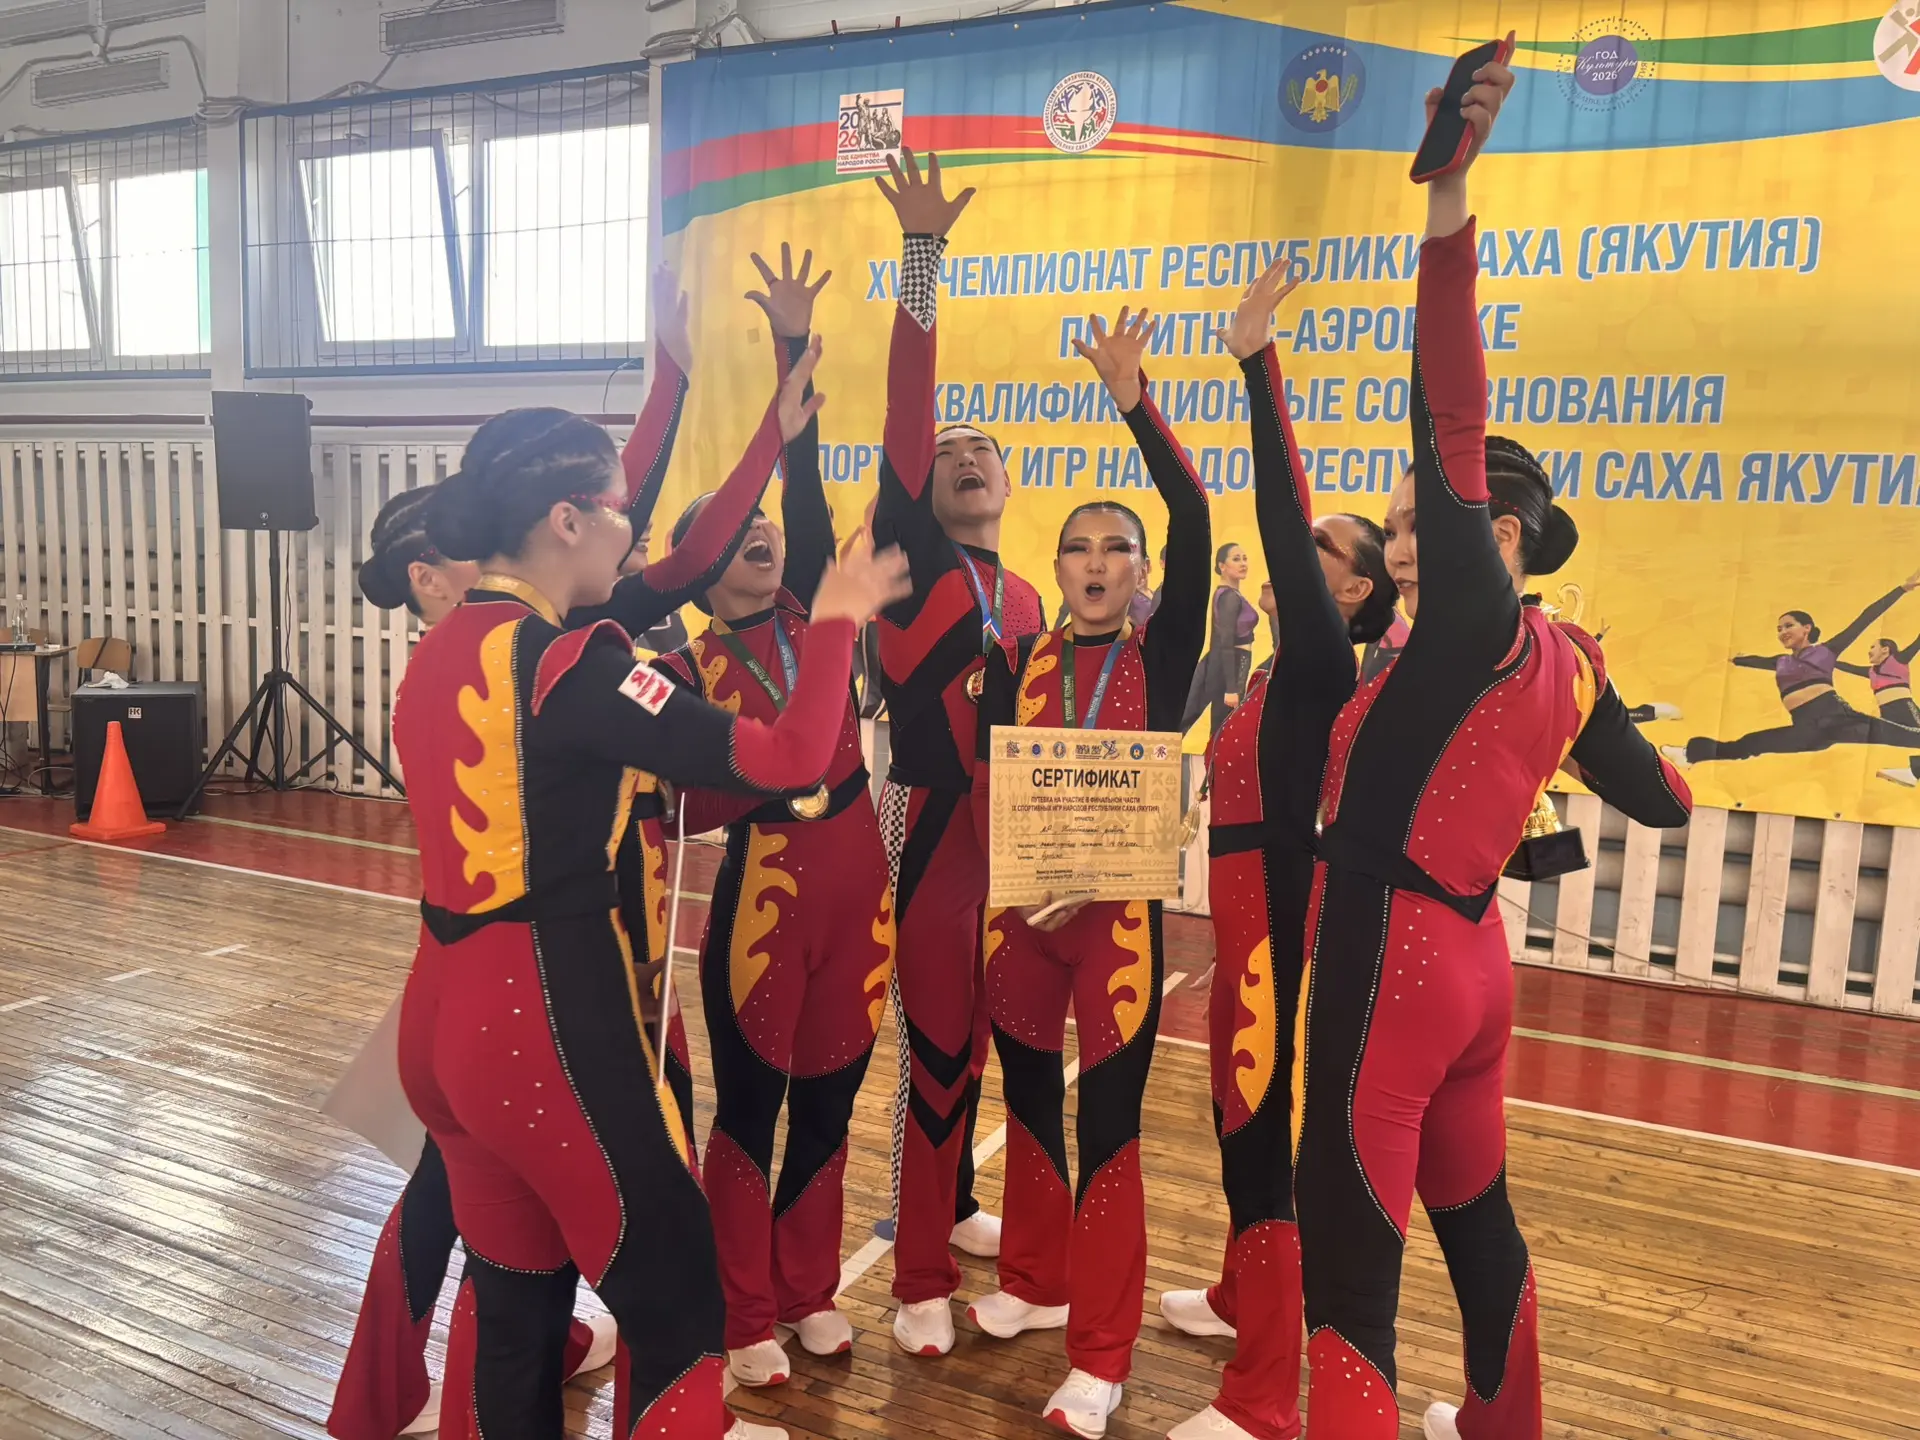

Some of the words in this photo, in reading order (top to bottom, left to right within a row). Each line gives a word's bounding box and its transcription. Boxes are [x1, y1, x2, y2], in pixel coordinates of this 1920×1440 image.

[1595, 50, 1618, 60] ГОД
[1592, 71, 1618, 81] 2026
[840, 111, 859, 130] 20
[839, 130, 859, 148] 26
[937, 247, 1151, 298] ЧЕМПИОНАТ
[1477, 228, 1561, 277] АХА
[1577, 216, 1821, 281] (ЯКУТИЯ)
[934, 377, 1346, 427] ВАЛИФИКЦИОНЫЕ
[1356, 376, 1725, 424] СОНОВАНИЯ
[1020, 446, 1088, 488] ИГР
[1095, 446, 1256, 495] НАДО
[1595, 452, 1723, 501] САХА
[1738, 452, 1920, 507] ЯКУТИ
[129, 708, 141, 716] HK
[1032, 768, 1140, 788] СЕРТИФИКАТ
